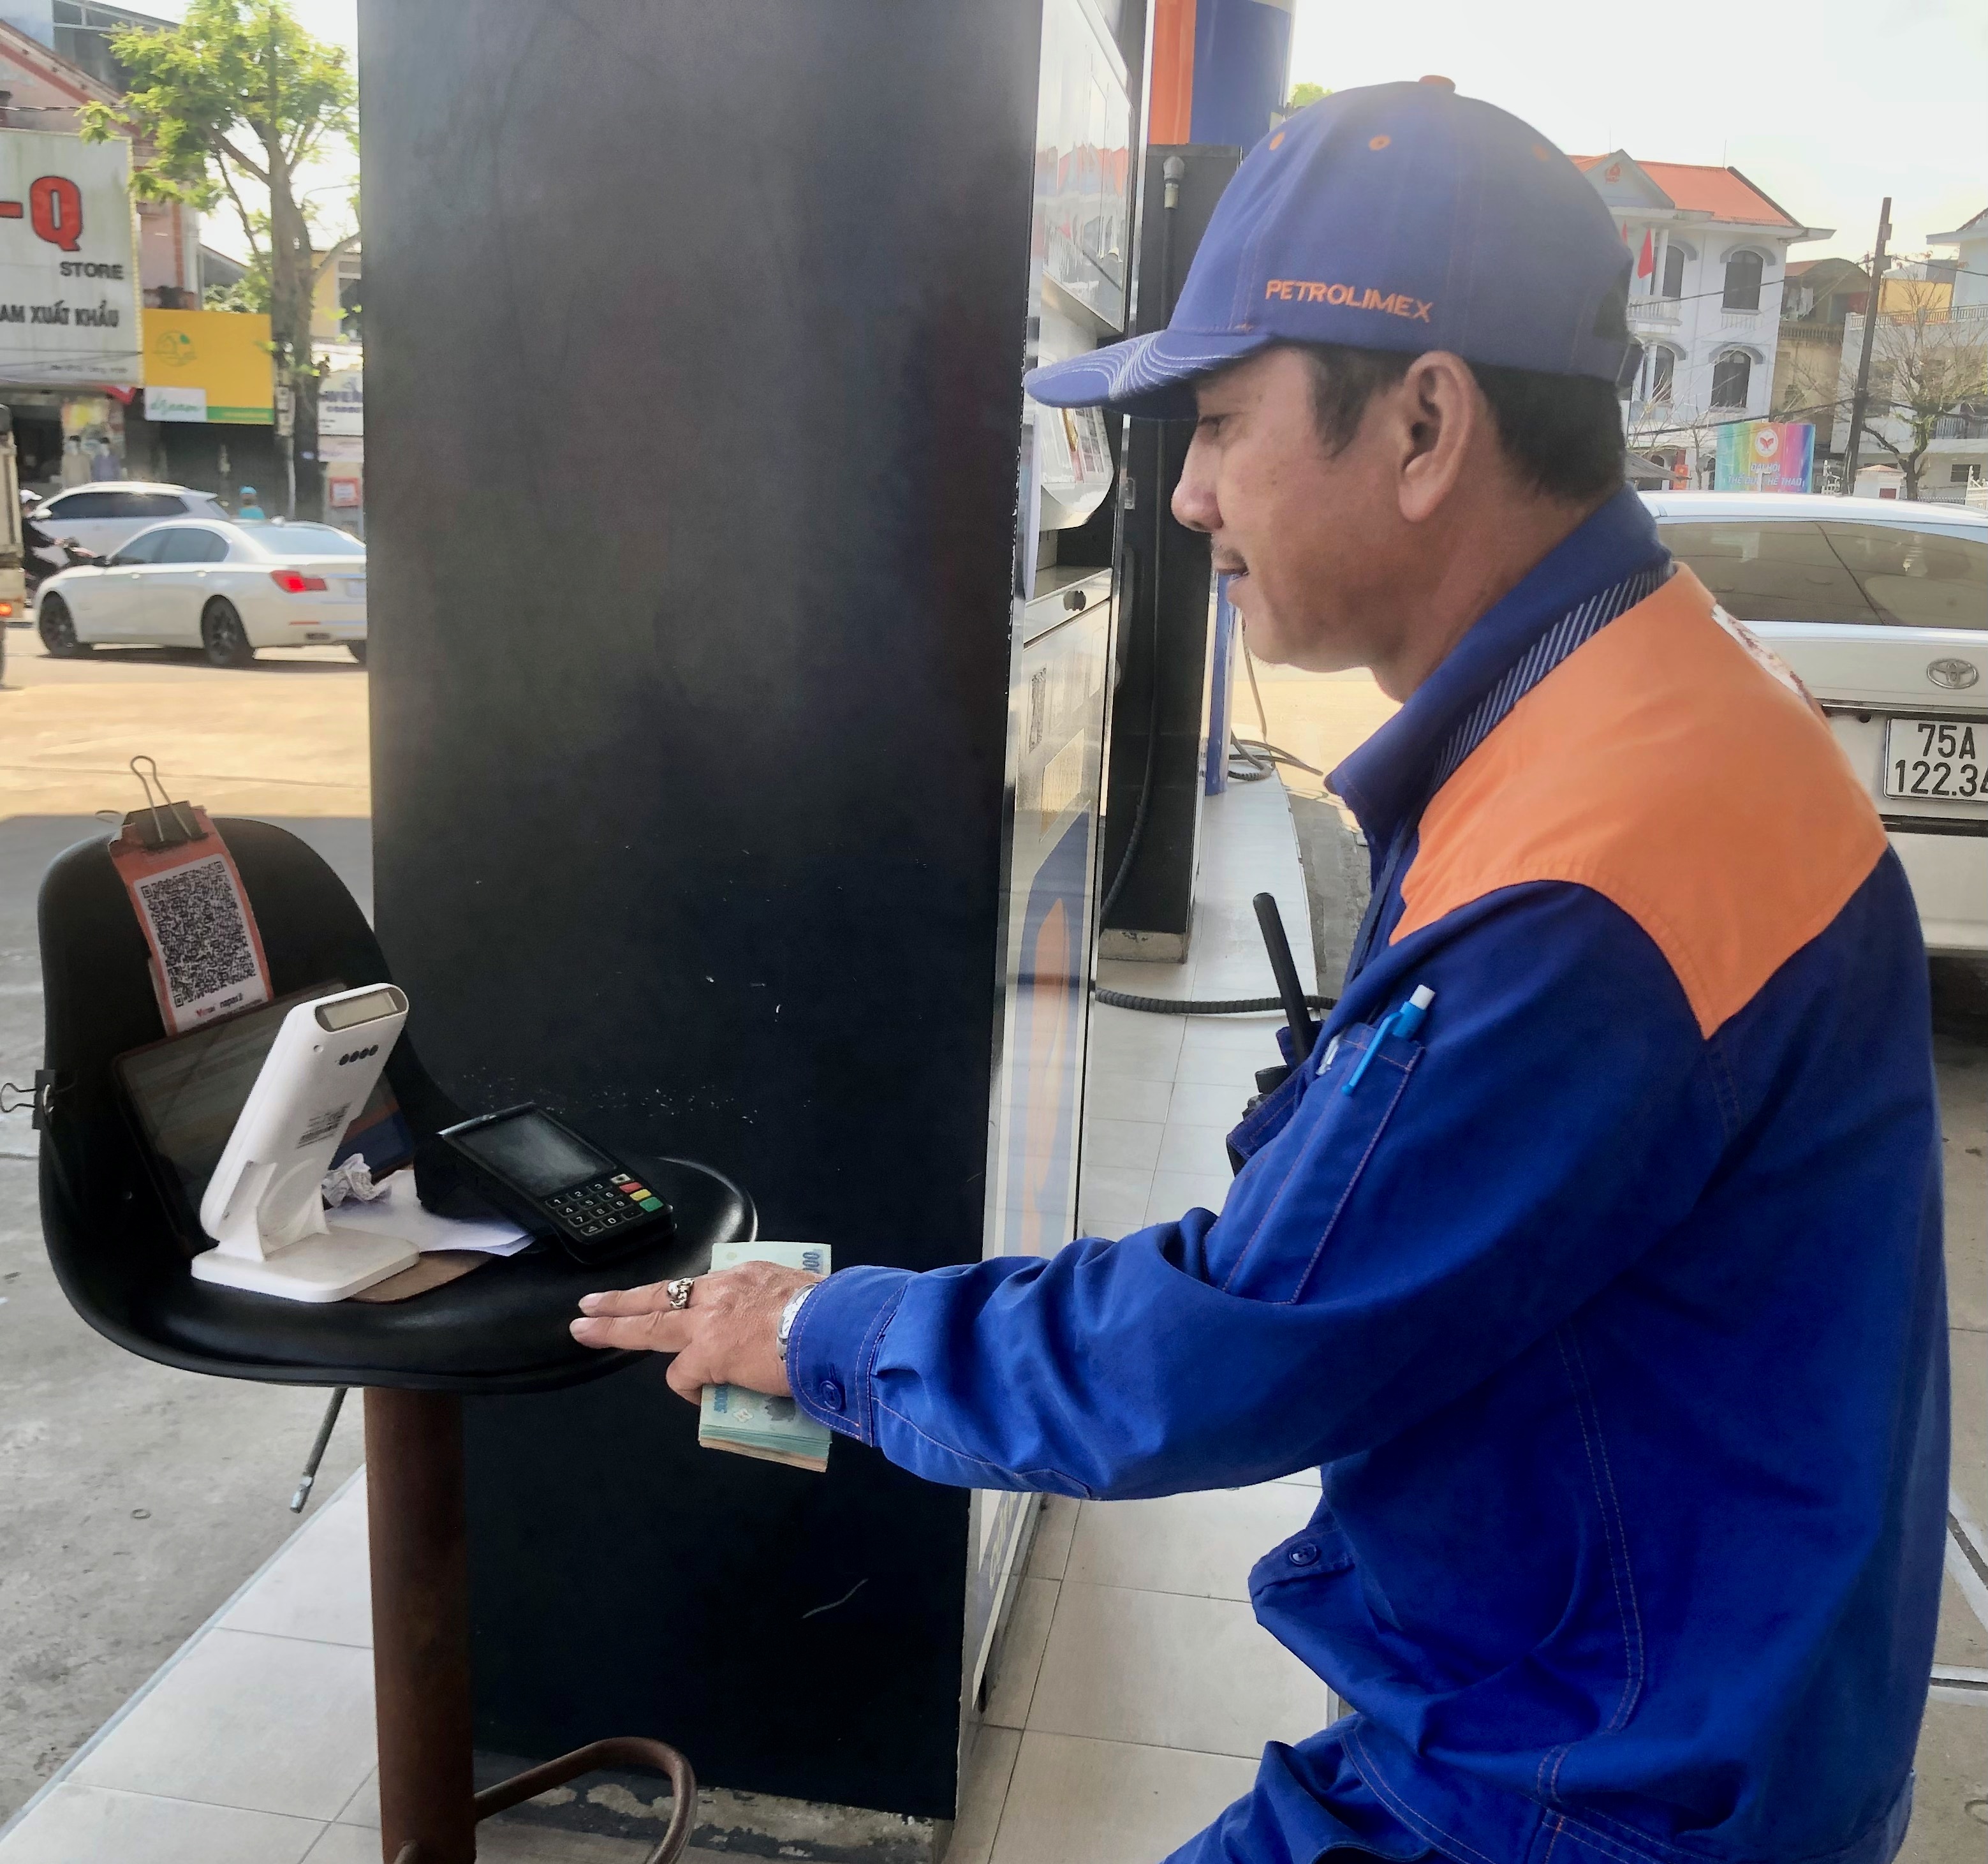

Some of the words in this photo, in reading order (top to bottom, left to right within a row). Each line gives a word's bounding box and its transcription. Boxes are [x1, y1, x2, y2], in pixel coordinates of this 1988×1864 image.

[59, 261, 124, 279] STORE
[1265, 279, 1433, 323] PETROLIMEX
[1918, 723, 1976, 760] 75A
